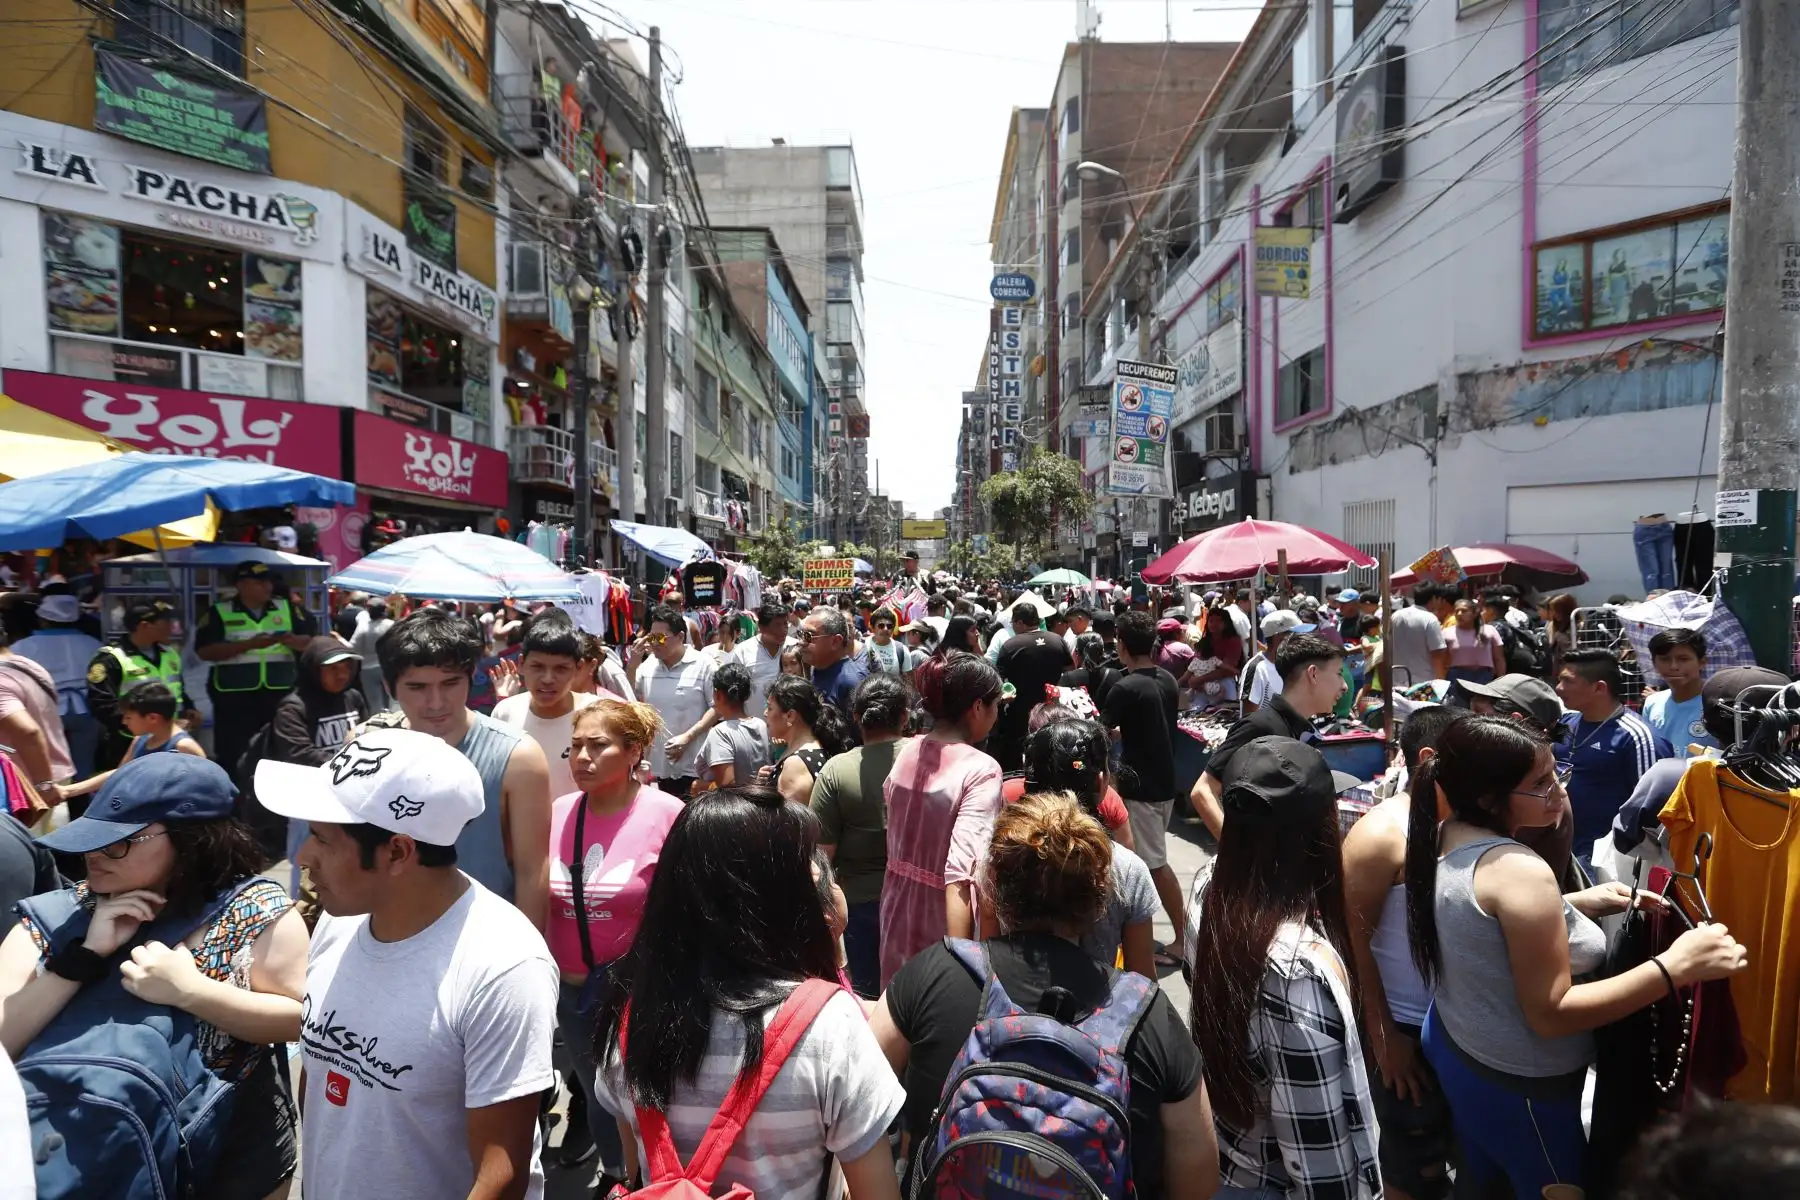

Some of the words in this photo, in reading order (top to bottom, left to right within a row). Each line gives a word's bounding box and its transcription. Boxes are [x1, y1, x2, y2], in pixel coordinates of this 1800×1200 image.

[31, 145, 98, 184] LA
[137, 169, 288, 226] PACHA
[1257, 246, 1309, 262] GORROS
[373, 232, 402, 272] LA
[420, 261, 484, 318] PACHA
[997, 277, 1026, 286] GALERIA
[993, 287, 1031, 297] COMERCIAL
[1119, 362, 1175, 381] RECUPEREMOS
[991, 332, 999, 449] INDUSTRIAL
[1189, 488, 1236, 520] Kebeya
[805, 559, 853, 569] COMAS
[805, 569, 822, 578] SAN
[824, 569, 853, 578] FELIPE
[301, 992, 413, 1079] Quiksilver
[305, 1046, 341, 1067] WATERMAN
